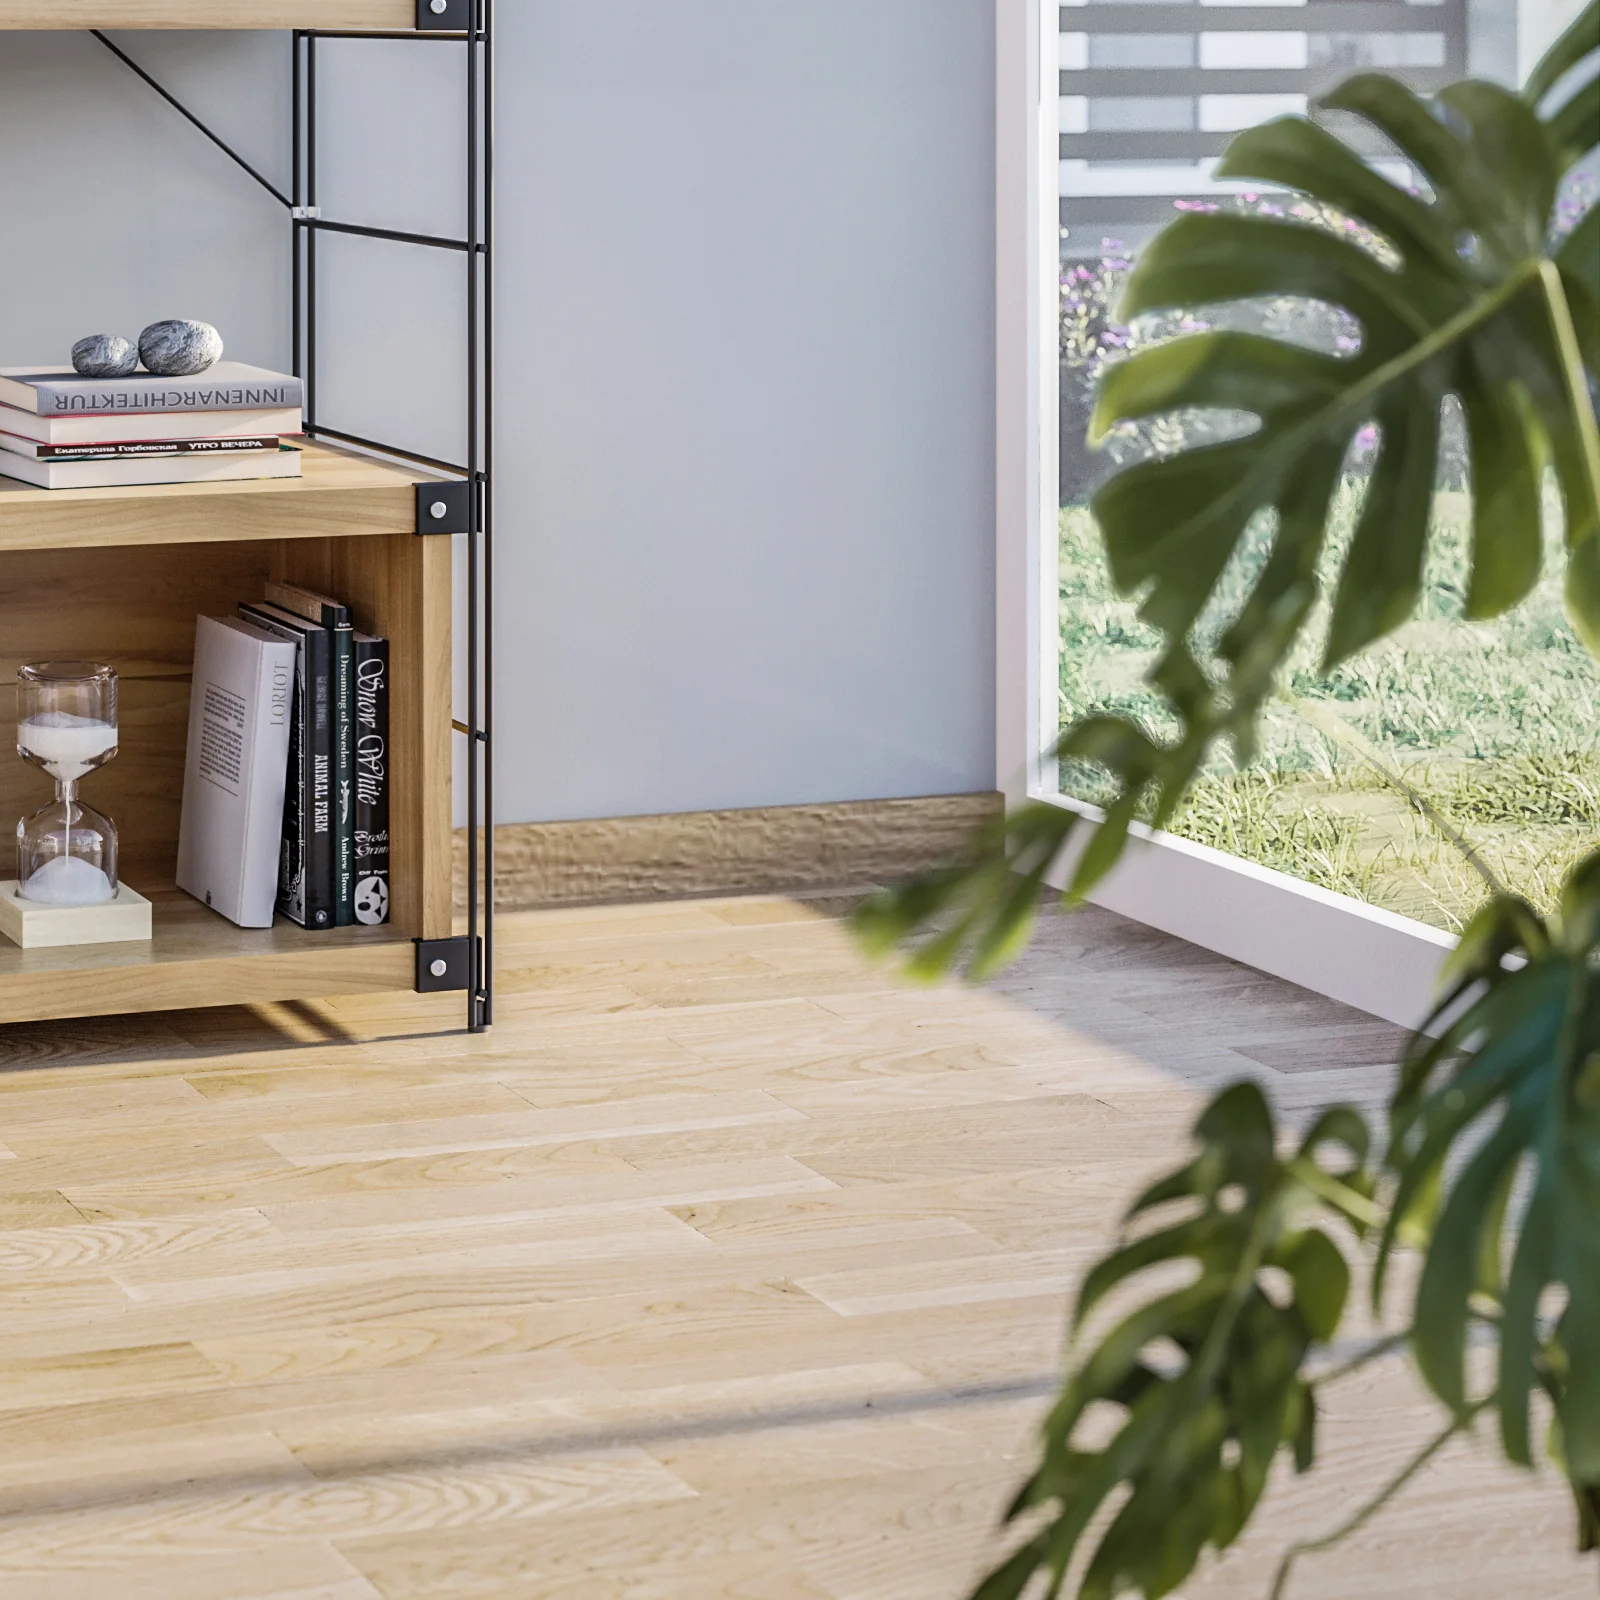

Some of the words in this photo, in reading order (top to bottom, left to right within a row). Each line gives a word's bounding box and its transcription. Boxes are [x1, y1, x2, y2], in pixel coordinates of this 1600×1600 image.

[54, 388, 286, 410] INNENARCHITEKTUR
[54, 445, 116, 455] Екатерина
[188, 442, 218, 450] УТРО
[220, 440, 263, 449] ВЕЧЕРА
[270, 662, 289, 727] LORIOT
[338, 654, 350, 708] Dreaming
[357, 658, 385, 729] Snow
[340, 709, 350, 723] of
[340, 723, 350, 769] Sweden
[314, 754, 329, 799] ANIMAL
[357, 734, 385, 806] White
[314, 801, 329, 833] FARM
[341, 835, 349, 870] Andrew
[341, 872, 349, 902] Brown
